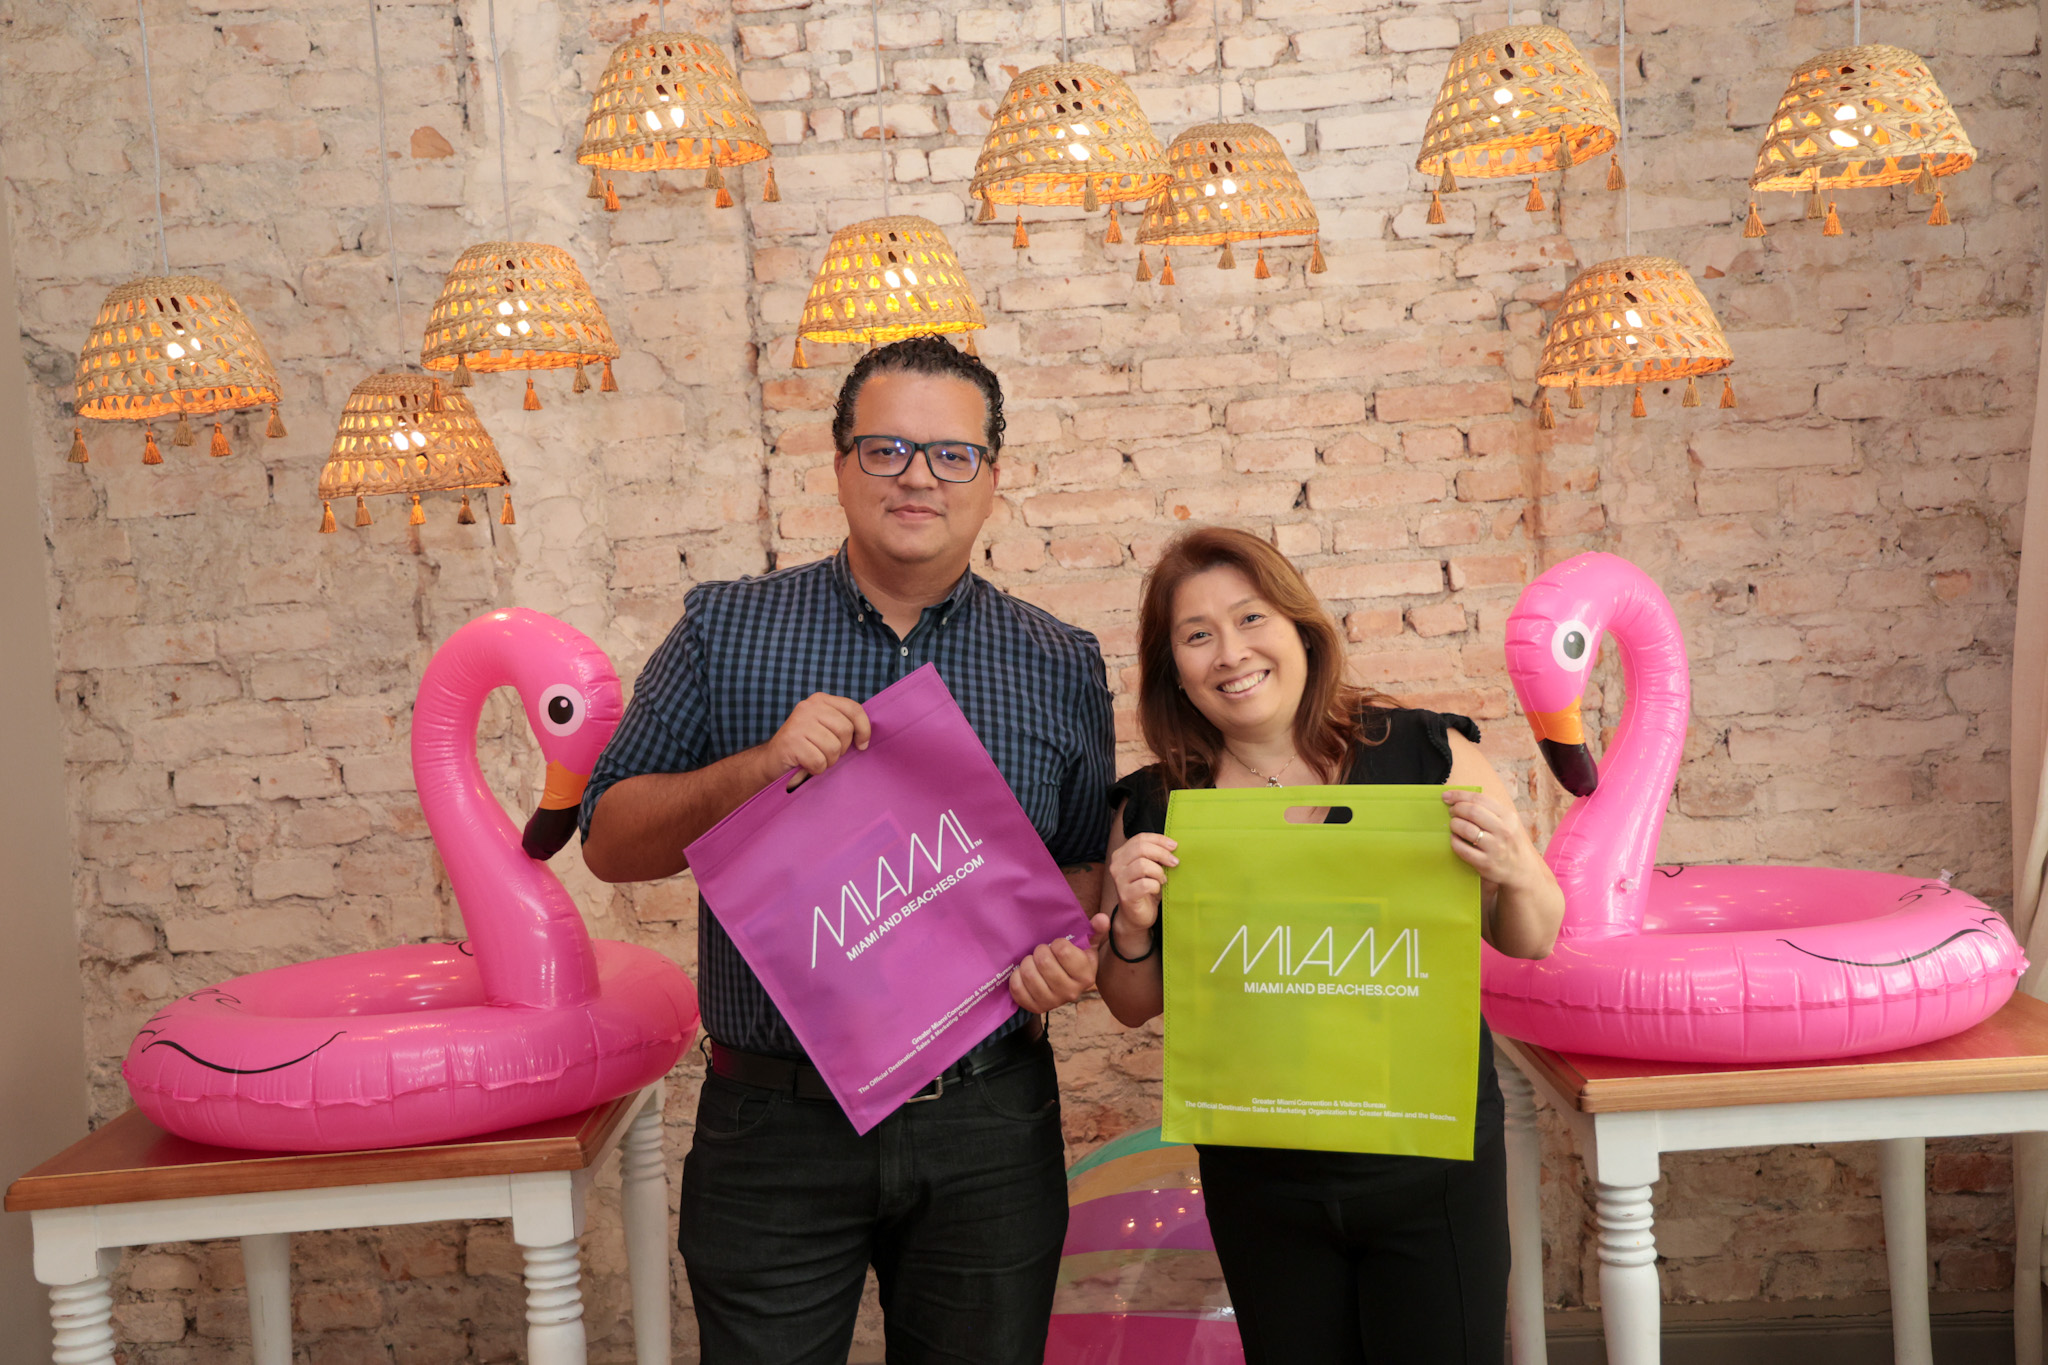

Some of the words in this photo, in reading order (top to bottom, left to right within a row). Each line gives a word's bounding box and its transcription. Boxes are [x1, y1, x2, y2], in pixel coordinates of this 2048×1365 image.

[811, 809, 976, 969] MIAMI
[846, 929, 880, 961] MIAMI
[878, 912, 903, 936] AND
[900, 854, 985, 918] BEACHES.COM
[1210, 925, 1419, 978] MIAMI
[1244, 982, 1283, 994] MIAMI
[1286, 983, 1316, 995] AND
[1317, 984, 1419, 997] BEACHES.COM
[858, 1085, 870, 1094] The
[869, 1070, 889, 1087] Official
[888, 1049, 917, 1073] Destination
[1197, 1102, 1218, 1110] Official
[1218, 1104, 1251, 1112] Destination
[1276, 1107, 1307, 1116] Marketing
[1308, 1108, 1347, 1117] Organization
[1359, 1109, 1382, 1117] Greater
[1429, 1113, 1458, 1121] Beaches.
[1340, 1100, 1362, 1108] Visitors
